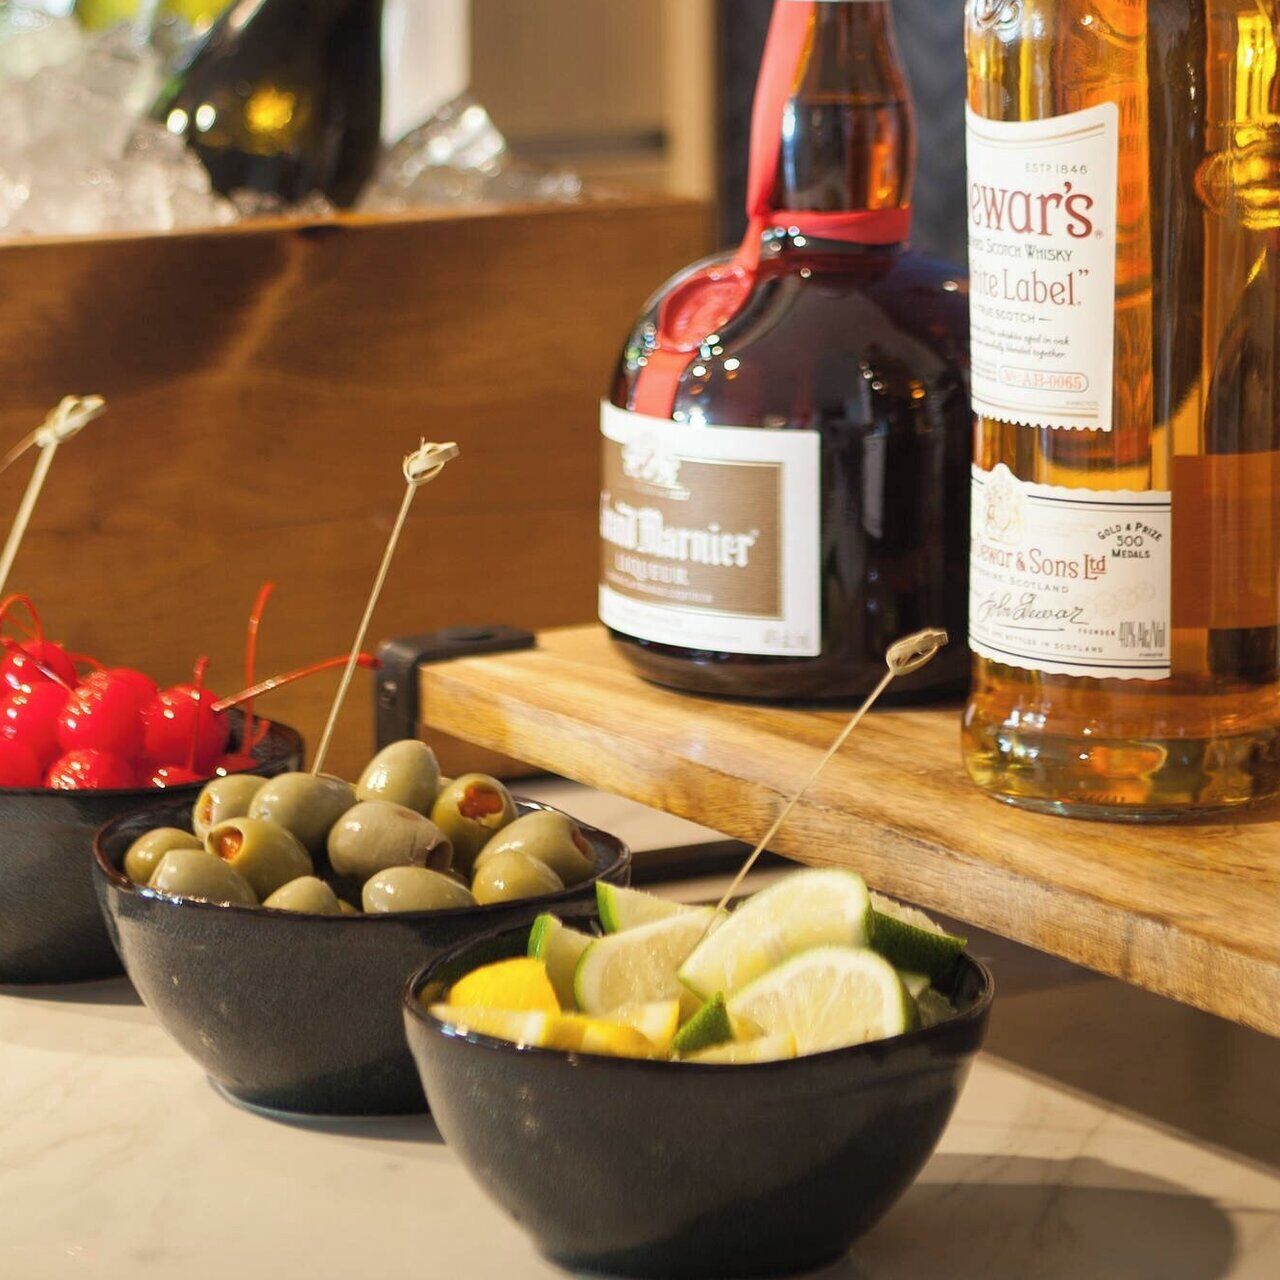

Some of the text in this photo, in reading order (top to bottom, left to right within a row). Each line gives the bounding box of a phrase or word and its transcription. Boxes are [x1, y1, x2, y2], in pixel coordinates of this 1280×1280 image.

[1055, 163, 1089, 175] 1846
[1024, 243, 1073, 261] WHISKY
[1097, 523, 1122, 541] GOLD
[1135, 521, 1163, 542] PRIZE
[1116, 535, 1145, 548] 500
[1111, 548, 1151, 560] MEDALS
[1029, 547, 1079, 579] Sons
[1083, 553, 1107, 580] Ltd
[1010, 576, 1070, 594] SCOTLAND
